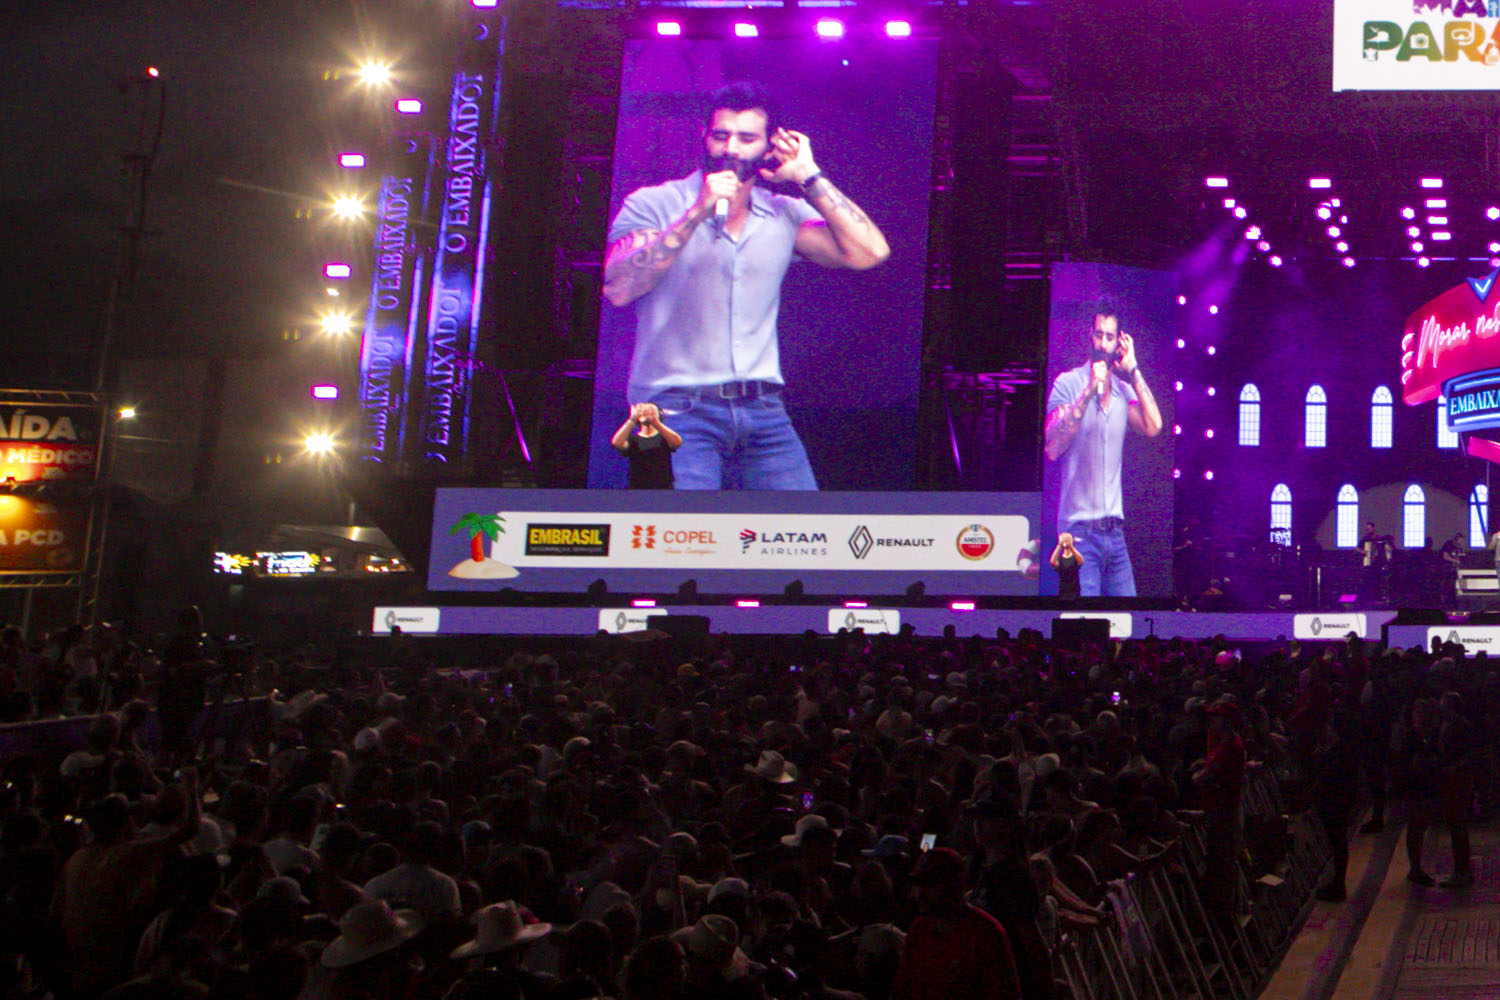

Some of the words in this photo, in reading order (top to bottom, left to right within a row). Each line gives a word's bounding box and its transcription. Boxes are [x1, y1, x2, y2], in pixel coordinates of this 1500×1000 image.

[7, 446, 96, 464] MÉDICO
[14, 530, 64, 545] PCD
[529, 528, 603, 546] EMBRASIL
[663, 531, 716, 544] COPEL
[761, 533, 827, 543] LATAM
[877, 538, 935, 547] RENAULT
[761, 548, 827, 556] AIRLINES
